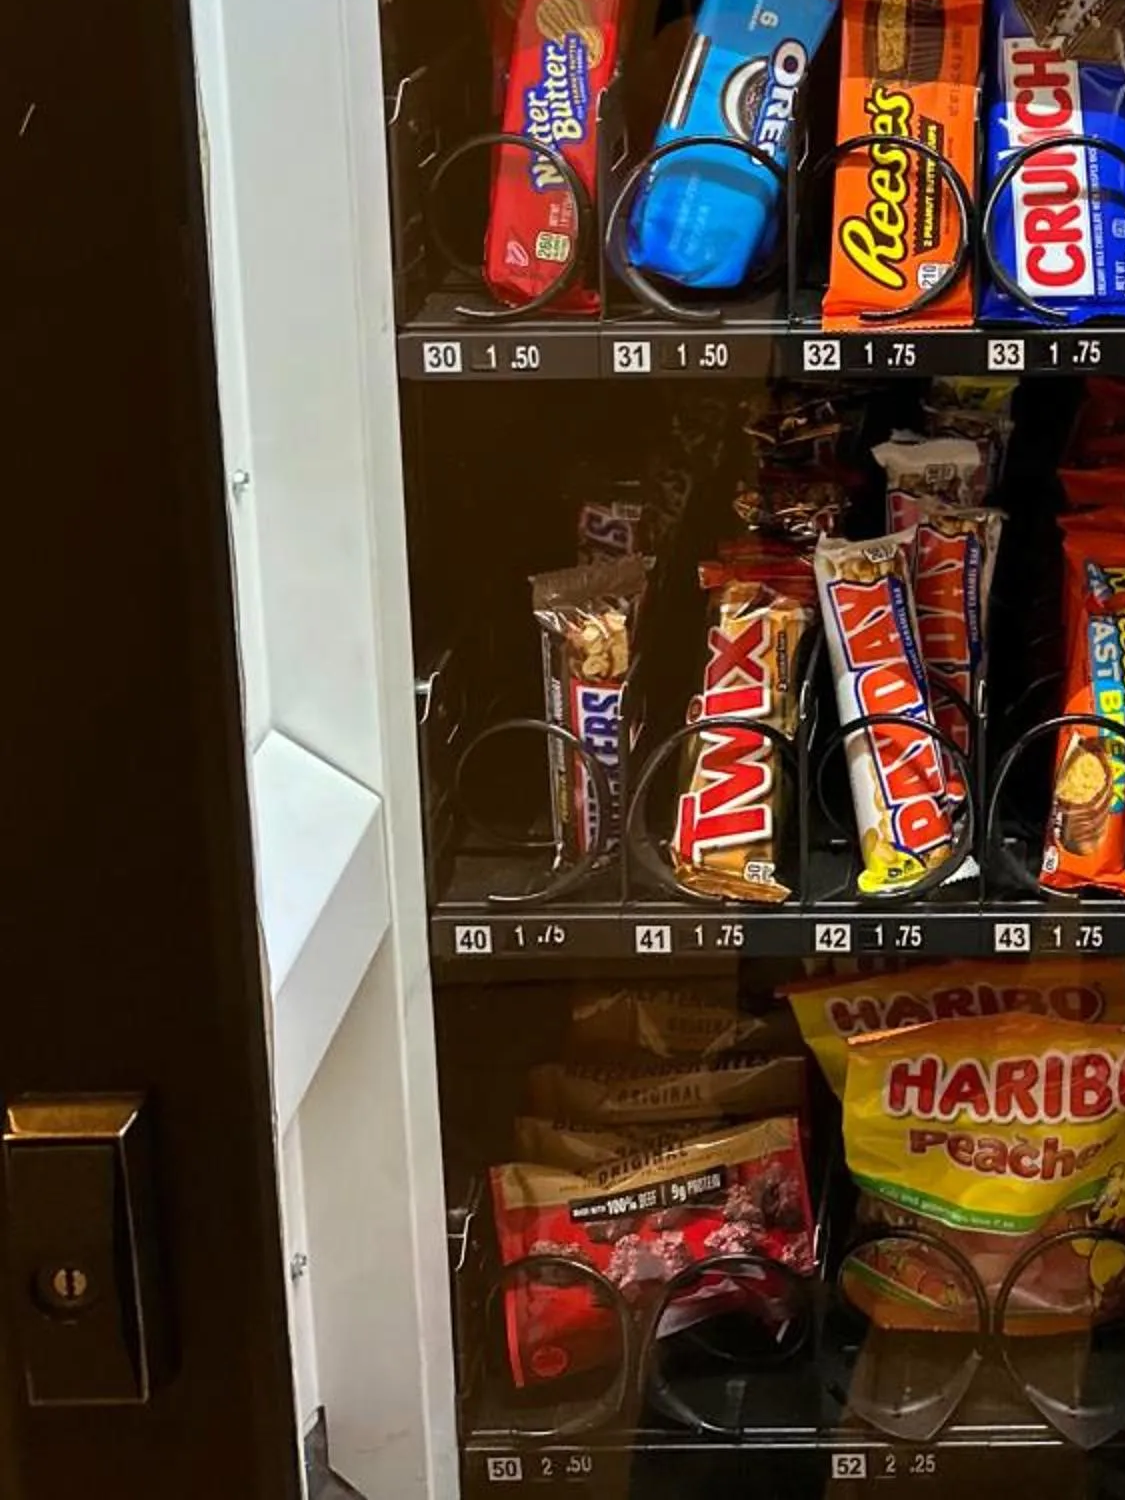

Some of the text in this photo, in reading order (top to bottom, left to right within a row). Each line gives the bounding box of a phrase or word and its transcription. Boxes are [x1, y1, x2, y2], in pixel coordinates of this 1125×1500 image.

[542, 43, 585, 141] Butter
[841, 86, 912, 290] Reese's
[428, 345, 457, 369] 30
[618, 345, 644, 368] 31
[808, 343, 836, 367] 32
[993, 343, 1020, 365] 33
[834, 582, 953, 854] PAYDAY
[459, 929, 487, 950] 40
[639, 929, 665, 949] 41
[819, 927, 847, 948] 42
[998, 927, 1026, 948] 43
[607, 1196, 637, 1216] 100%
[671, 1183, 687, 1203] 9g
[687, 1173, 721, 1196] PROTEIN
[492, 1459, 518, 1478] 50
[837, 1457, 862, 1476] 52
